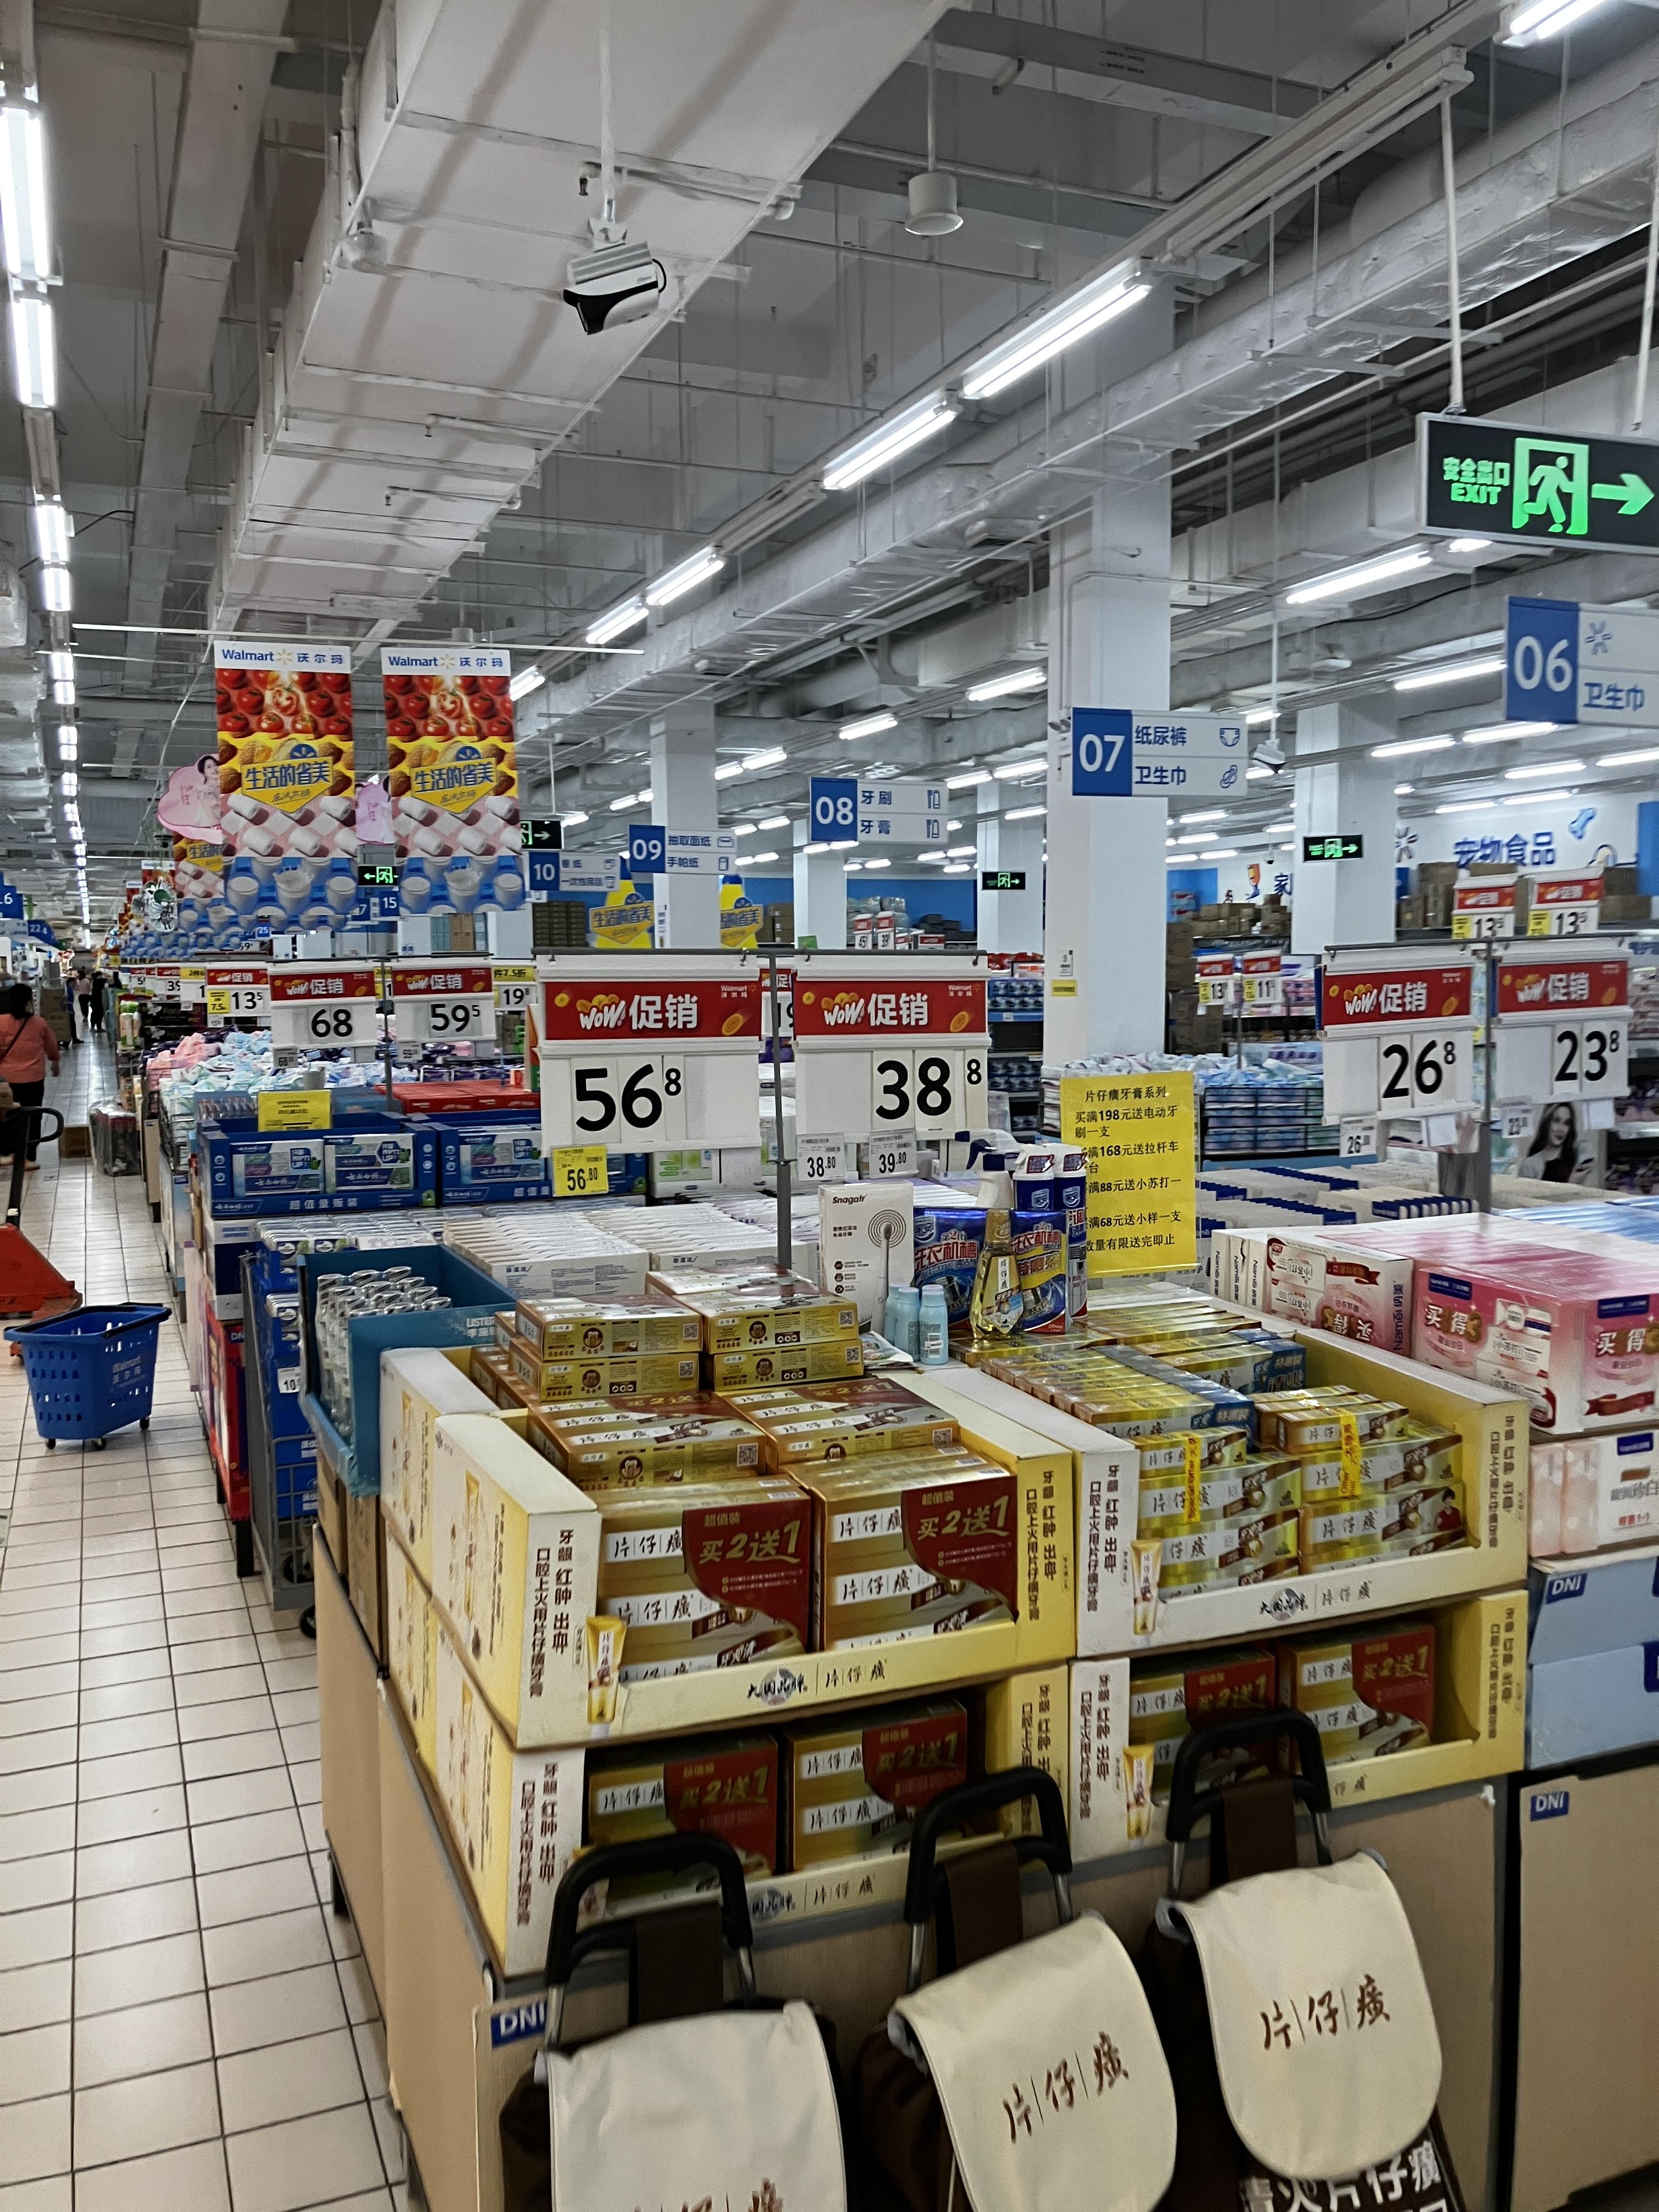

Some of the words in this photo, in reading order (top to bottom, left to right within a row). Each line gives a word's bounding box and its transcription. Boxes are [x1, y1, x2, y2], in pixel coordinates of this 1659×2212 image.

[1443, 456, 1510, 487] 安全出口
[1451, 483, 1502, 505] EXIT
[222, 648, 274, 662] Walmart
[388, 656, 438, 668] Walmart
[1514, 635, 1572, 692] 06
[1583, 682, 1644, 712] 卫生巾
[1135, 725, 1188, 747] 纸尿裤
[1079, 733, 1126, 772] 07
[245, 760, 331, 792] 生活的省美
[415, 761, 494, 792] 生活的省美
[1135, 765, 1187, 786] 卫生巾
[815, 796, 854, 825] 08
[860, 790, 893, 806] 牙刷
[668, 834, 711, 848] 抽取面纸
[860, 819, 891, 835] 牙膏
[633, 838, 662, 860] 09
[667, 856, 699, 868] 手帕纸
[1453, 832, 1557, 868] 宠物食品
[533, 863, 555, 881] 10
[382, 897, 397, 909] 15
[309, 978, 343, 995] 促销
[430, 974, 462, 990] 促销
[720, 984, 748, 992] Walmart
[1547, 972, 1590, 1003] 促销
[868, 992, 928, 1026] 促销
[1379, 981, 1427, 1014] 促销
[311, 1008, 353, 1038] 68
[629, 994, 698, 1030] 促销
[1085, 1086, 1167, 1103] 片仔癀牙膏系列
[1075, 1105, 1178, 1124] 买满198元送电动牙
[1075, 1126, 1110, 1139] 刷一支
[807, 1155, 836, 1177] 38.80
[878, 1151, 907, 1174] 39.80
[567, 1166, 598, 1192] 56.80
[1086, 1177, 1182, 1194] 满88元送小苏打一
[289, 1198, 359, 1210] 超值量贩装
[1086, 1210, 1182, 1228] 满68元送小样一支
[230, 1332, 245, 1341] DN
[1042, 1471, 1054, 1499] 牙龈
[1106, 1465, 1120, 1493] 牙龈
[917, 1495, 1010, 1541] 买2送1
[1042, 1505, 1056, 1538] 红肿
[1105, 1498, 1119, 1532] 红肿
[557, 1528, 574, 1562] 牙龈
[699, 1520, 801, 1564] 买2送1
[1103, 1537, 1118, 1573] 出血
[1043, 1543, 1057, 1581] 出血
[554, 1567, 573, 1606] 红肿
[842, 1569, 910, 1600] 片仔癀
[1551, 1575, 1582, 1595] DNI
[530, 1547, 551, 1698] 口腔上火用片仔癀牙膏
[618, 1594, 691, 1627] 片仔癀
[551, 1612, 569, 1656] 出血
[1536, 1793, 1565, 1811] DNI
[1260, 1974, 1390, 2050] 片仔癀
[1002, 2030, 1129, 2143] 片仔癀
